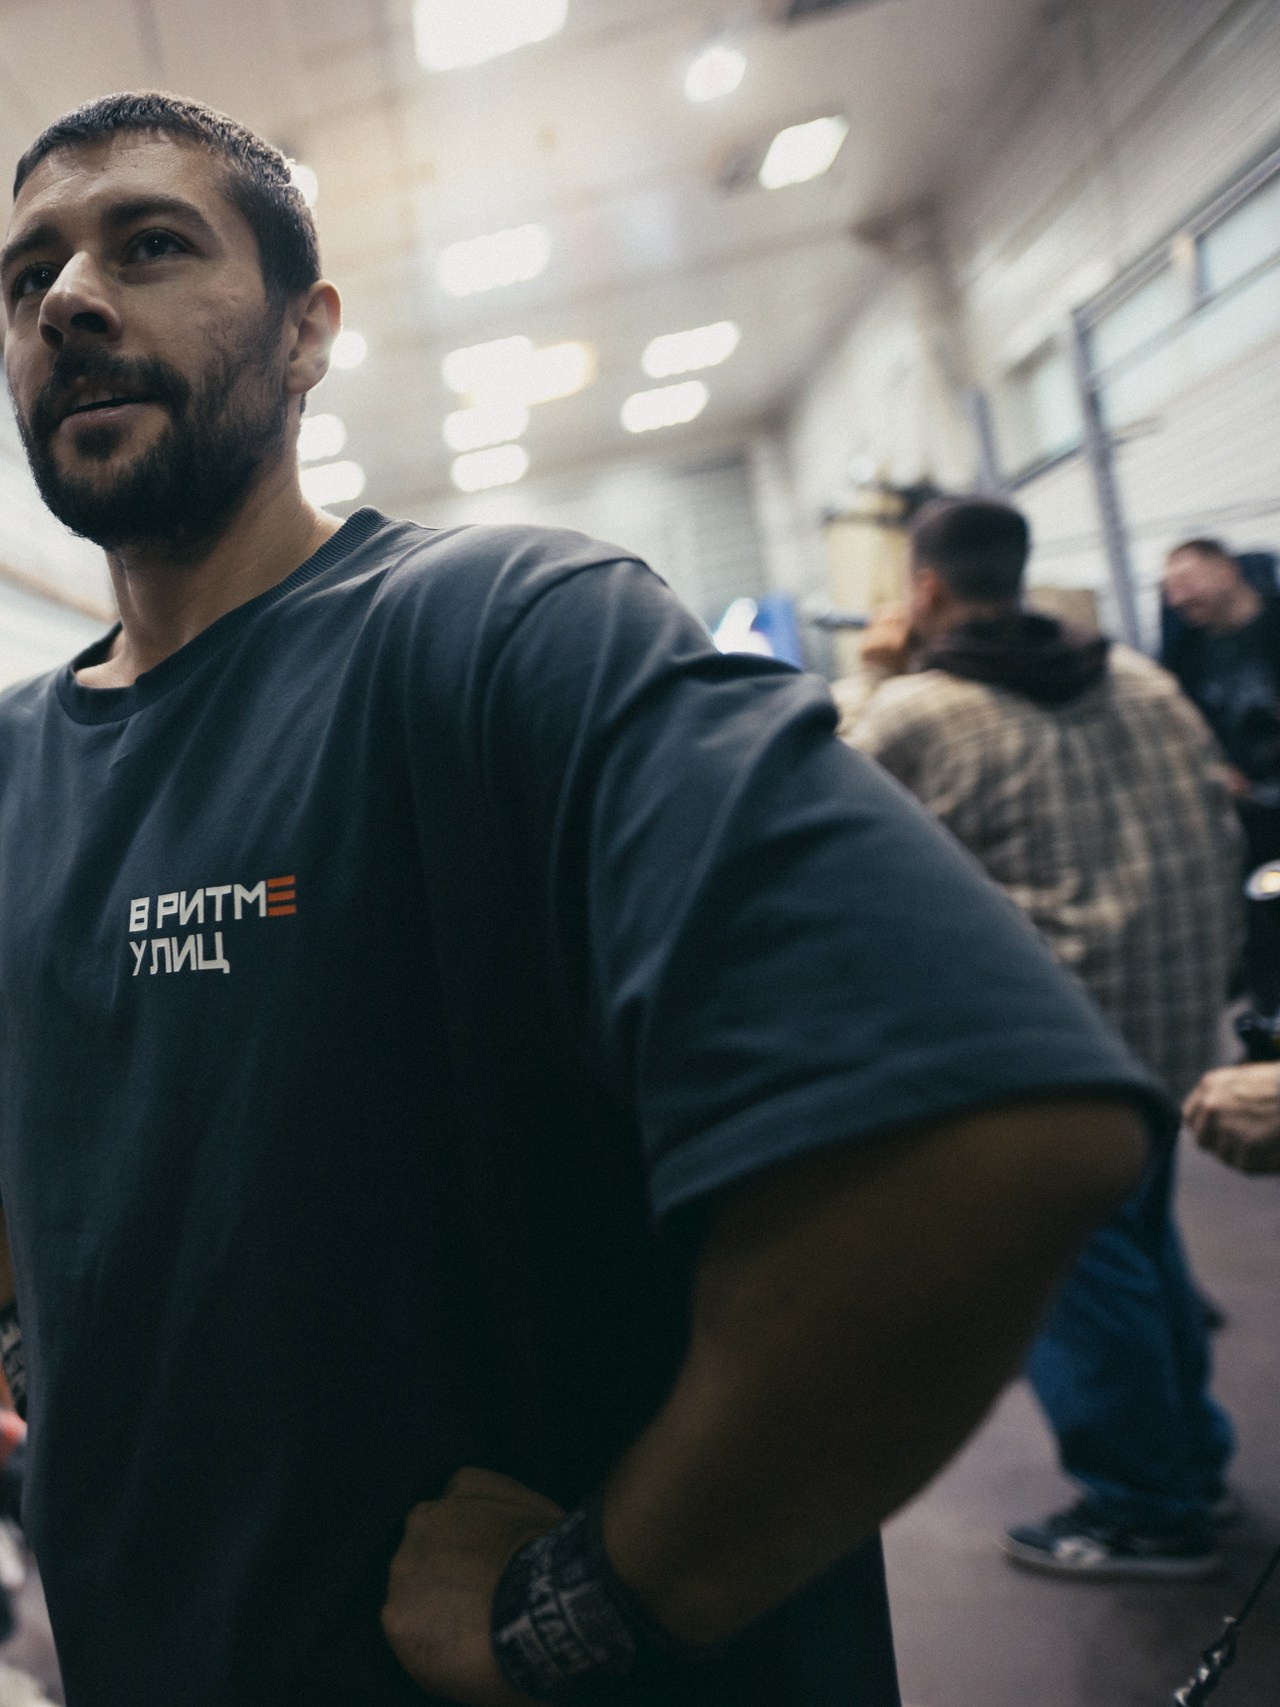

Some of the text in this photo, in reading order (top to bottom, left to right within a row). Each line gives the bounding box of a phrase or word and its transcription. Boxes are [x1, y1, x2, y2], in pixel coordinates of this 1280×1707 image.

[129, 875, 297, 932] В РИТМЕ
[129, 931, 231, 976] УЛИЦ
